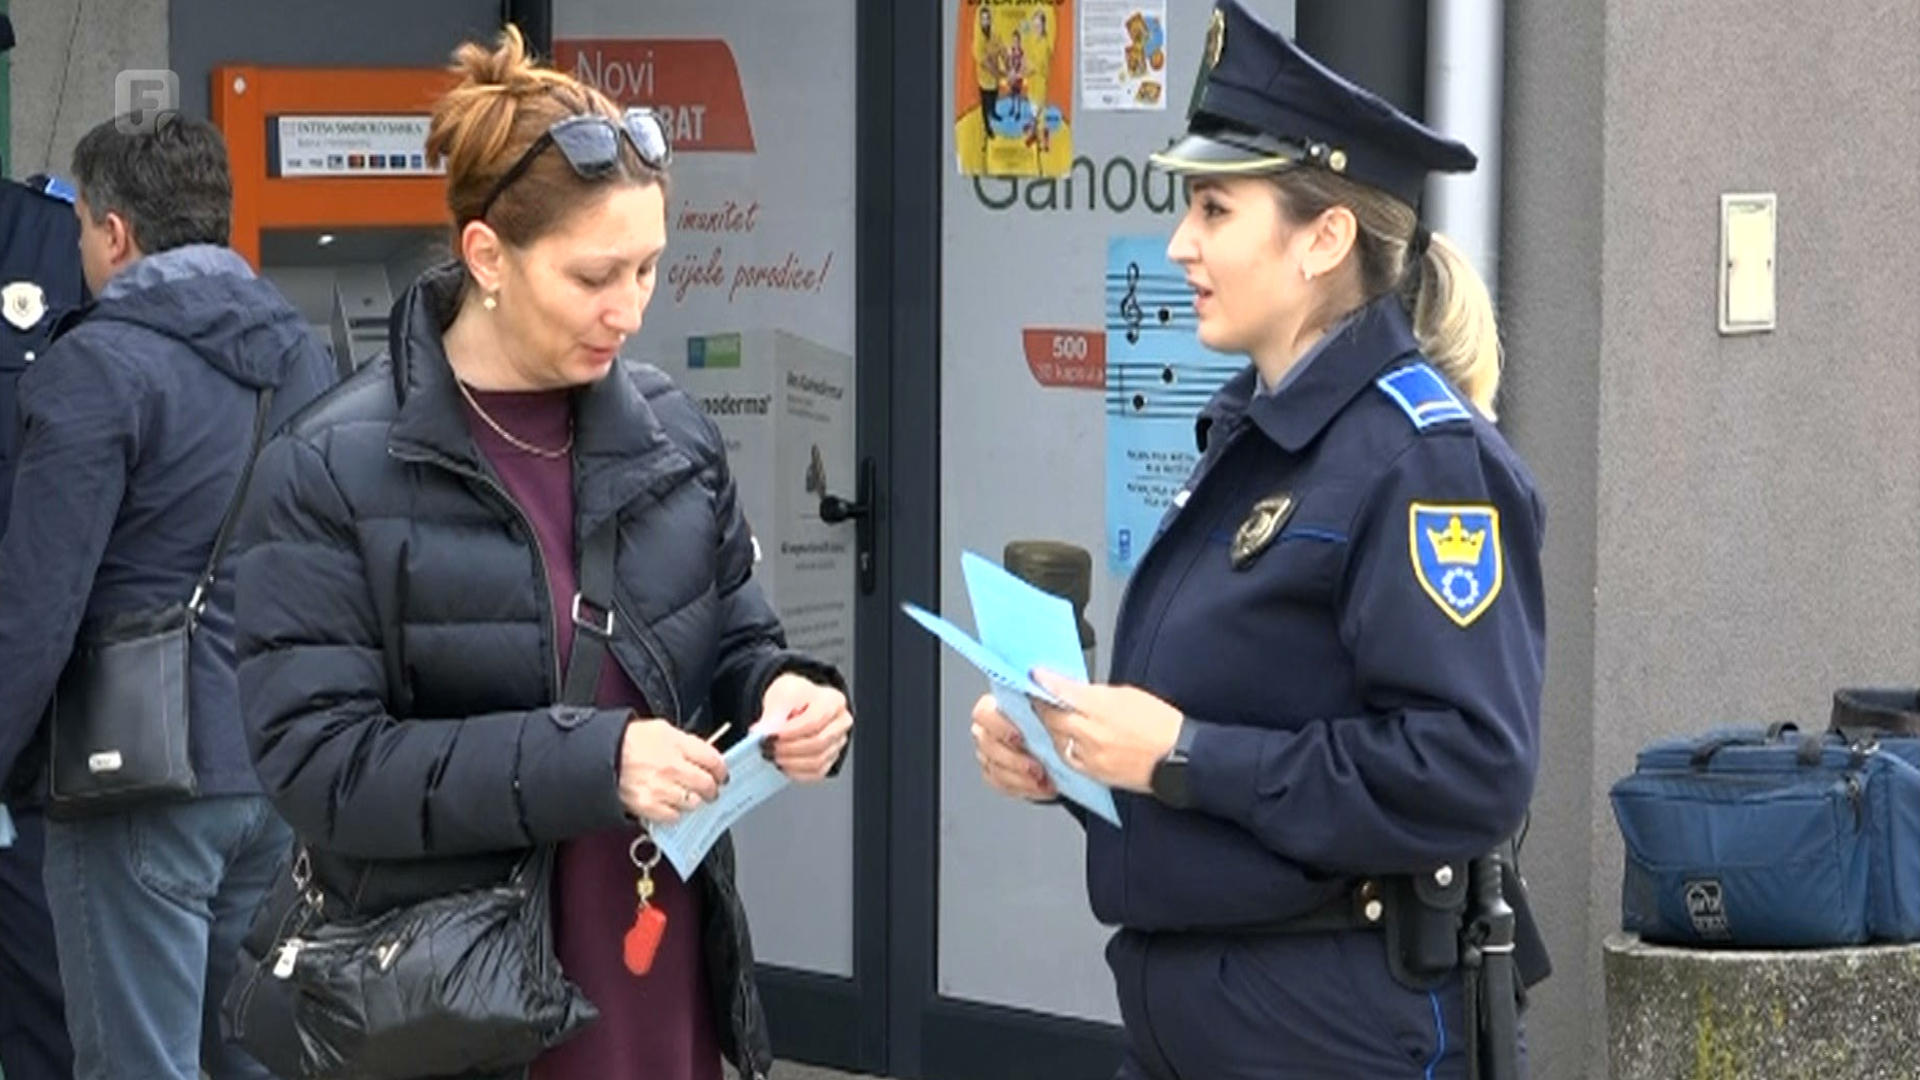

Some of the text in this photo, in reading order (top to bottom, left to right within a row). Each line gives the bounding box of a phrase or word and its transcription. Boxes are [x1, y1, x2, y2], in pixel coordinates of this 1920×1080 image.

[575, 49, 655, 96] Novi
[658, 105, 707, 142] BAT
[972, 137, 1194, 214] Ganod
[728, 251, 834, 302] porodice!
[1052, 335, 1088, 361] 500
